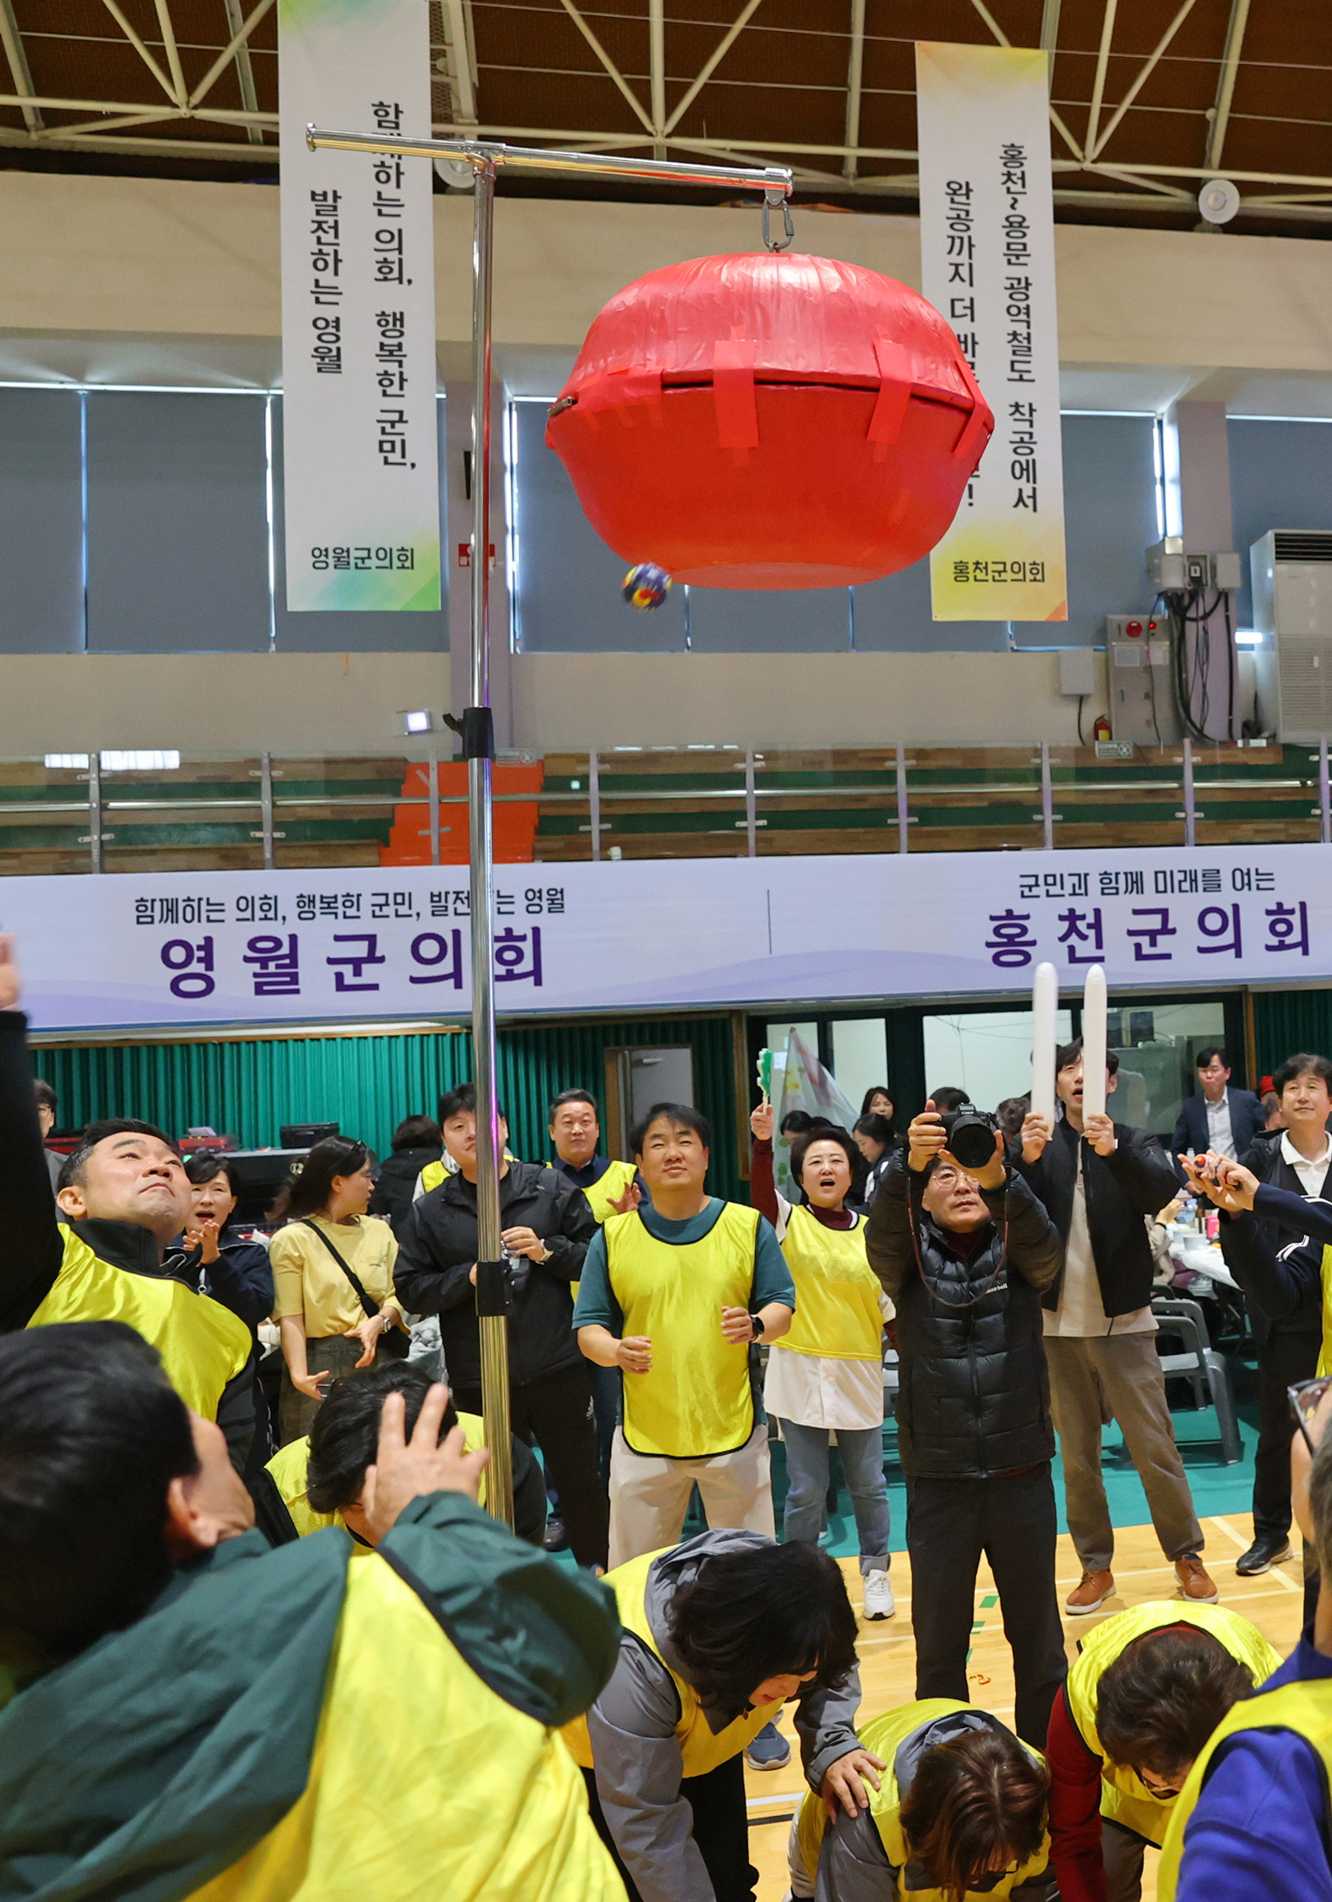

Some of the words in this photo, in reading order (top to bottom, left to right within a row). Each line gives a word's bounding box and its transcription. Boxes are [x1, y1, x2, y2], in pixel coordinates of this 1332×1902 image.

[371, 101, 405, 218] 함하는
[310, 189, 343, 306] 발전하는
[373, 228, 413, 286] 의회,
[945, 180, 976, 288] 완공까지
[950, 296, 975, 323] 더
[1004, 276, 1036, 383] 광역철도
[311, 316, 342, 374] 영월
[375, 310, 409, 398] 행복한
[376, 409, 416, 470] 군민,
[1008, 401, 1038, 513] 착공에서
[311, 546, 415, 571] 영월군의회
[953, 560, 1045, 583] 홍천군의회
[135, 896, 226, 925] 함께하는
[235, 894, 287, 925] 의회,
[296, 892, 363, 921] 행복한
[371, 891, 421, 921] 군민,
[429, 889, 515, 917] 발전는
[524, 886, 565, 914] 영월
[1019, 872, 1090, 899] 군민과
[1098, 870, 1144, 896] 함께
[1153, 868, 1222, 894] 미래를
[1231, 867, 1275, 892] 여는
[158, 926, 543, 999] 영월군의회
[984, 900, 1310, 968] 홍천군의회
